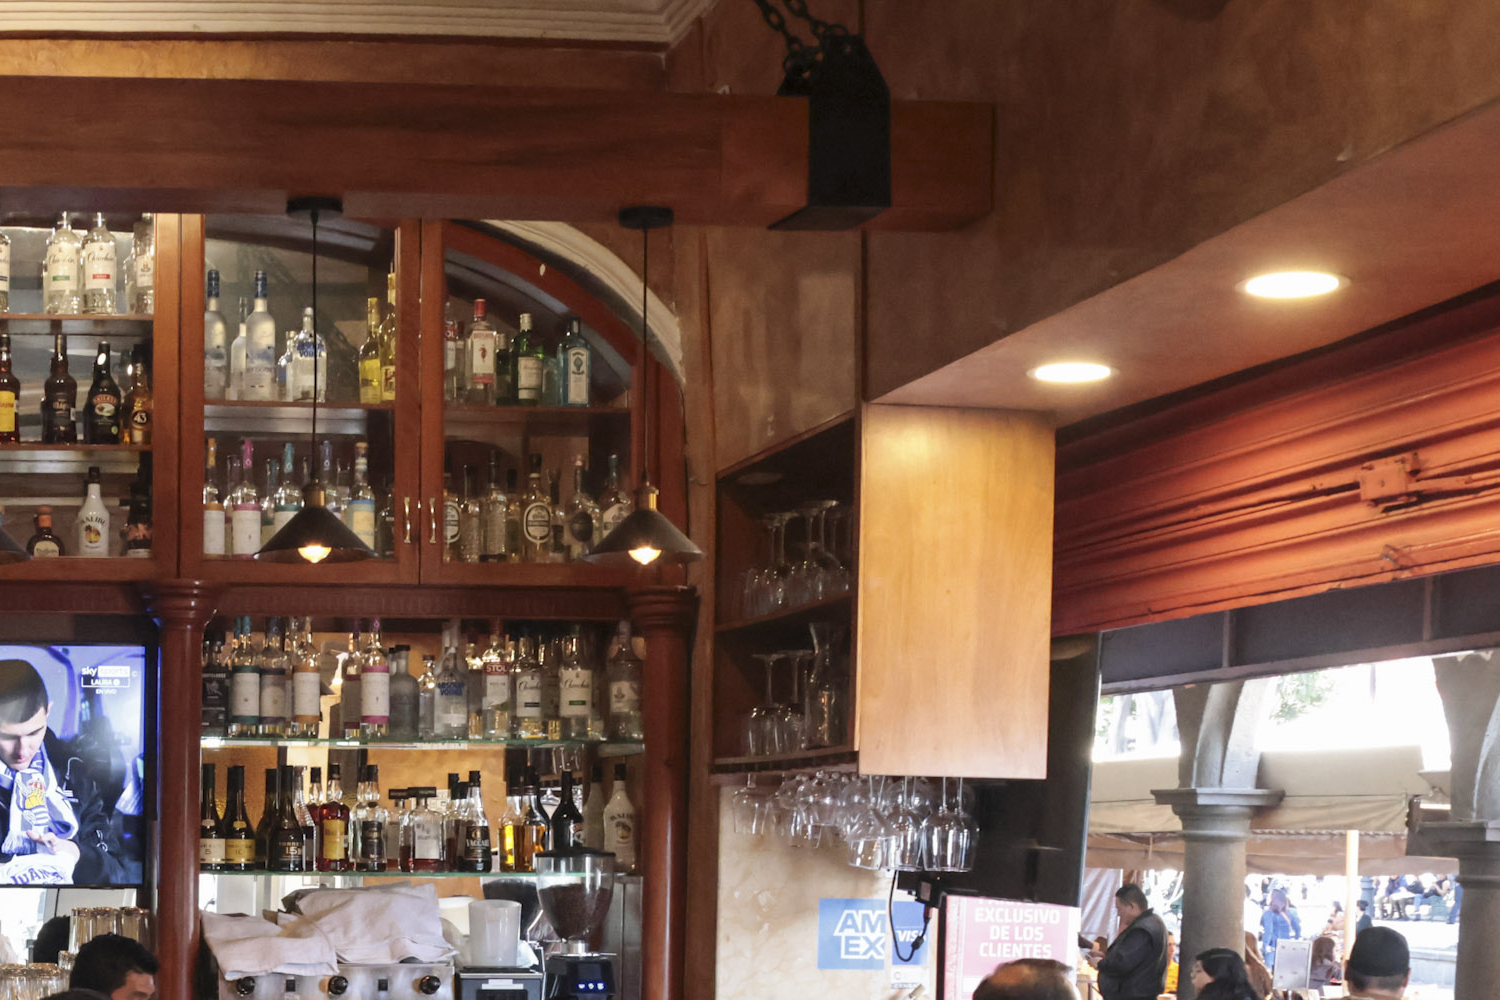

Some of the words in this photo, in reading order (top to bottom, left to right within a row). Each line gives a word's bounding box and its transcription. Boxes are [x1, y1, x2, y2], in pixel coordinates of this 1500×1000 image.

[134, 412, 147, 424] 43
[82, 666, 97, 677] sky
[833, 910, 886, 936] AM
[974, 908, 1060, 924] EXCLUSIVO
[990, 925, 1010, 940] DE
[1014, 926, 1044, 941] LOS
[840, 936, 886, 960] EX
[979, 942, 1052, 959] CLIENTES
